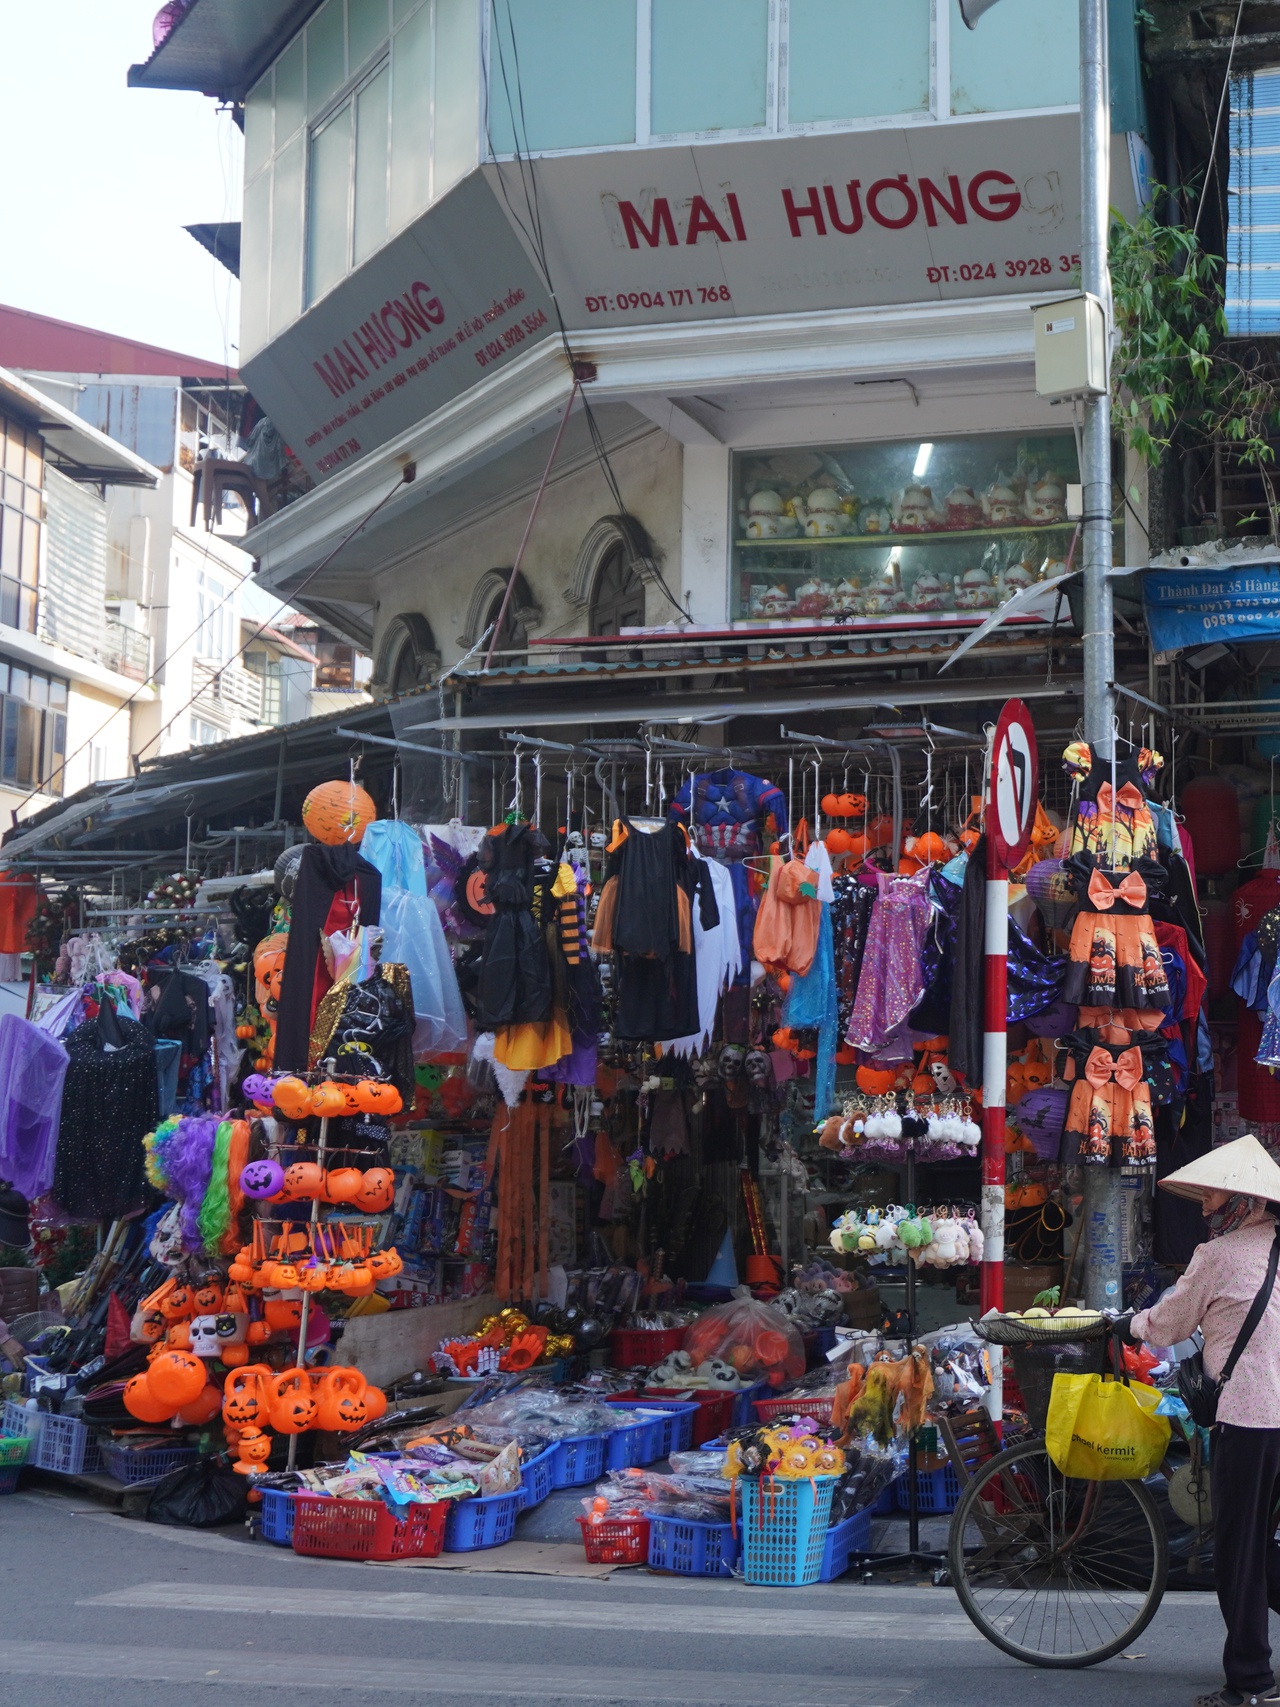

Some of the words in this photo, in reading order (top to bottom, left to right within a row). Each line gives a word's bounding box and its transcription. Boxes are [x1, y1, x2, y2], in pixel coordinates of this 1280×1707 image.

[618, 191, 747, 249] MAI
[781, 170, 1022, 237] HƯƠNG
[1004, 257, 1053, 278] 3928
[585, 291, 665, 313] ĐT:0904
[667, 289, 695, 307] 171
[698, 286, 732, 304] 768
[313, 339, 369, 399] MAI
[352, 281, 445, 370] HƯƠNG
[501, 324, 525, 348] 3928
[521, 308, 548, 335] 3564
[1158, 583, 1199, 599] Thành
[1202, 581, 1226, 597] Đạt
[1228, 580, 1242, 592] 35
[1245, 579, 1279, 594] Hàng
[1203, 614, 1235, 630] 0988
[1072, 1433, 1095, 1450] chael
[1097, 1443, 1136, 1456] Kermit
